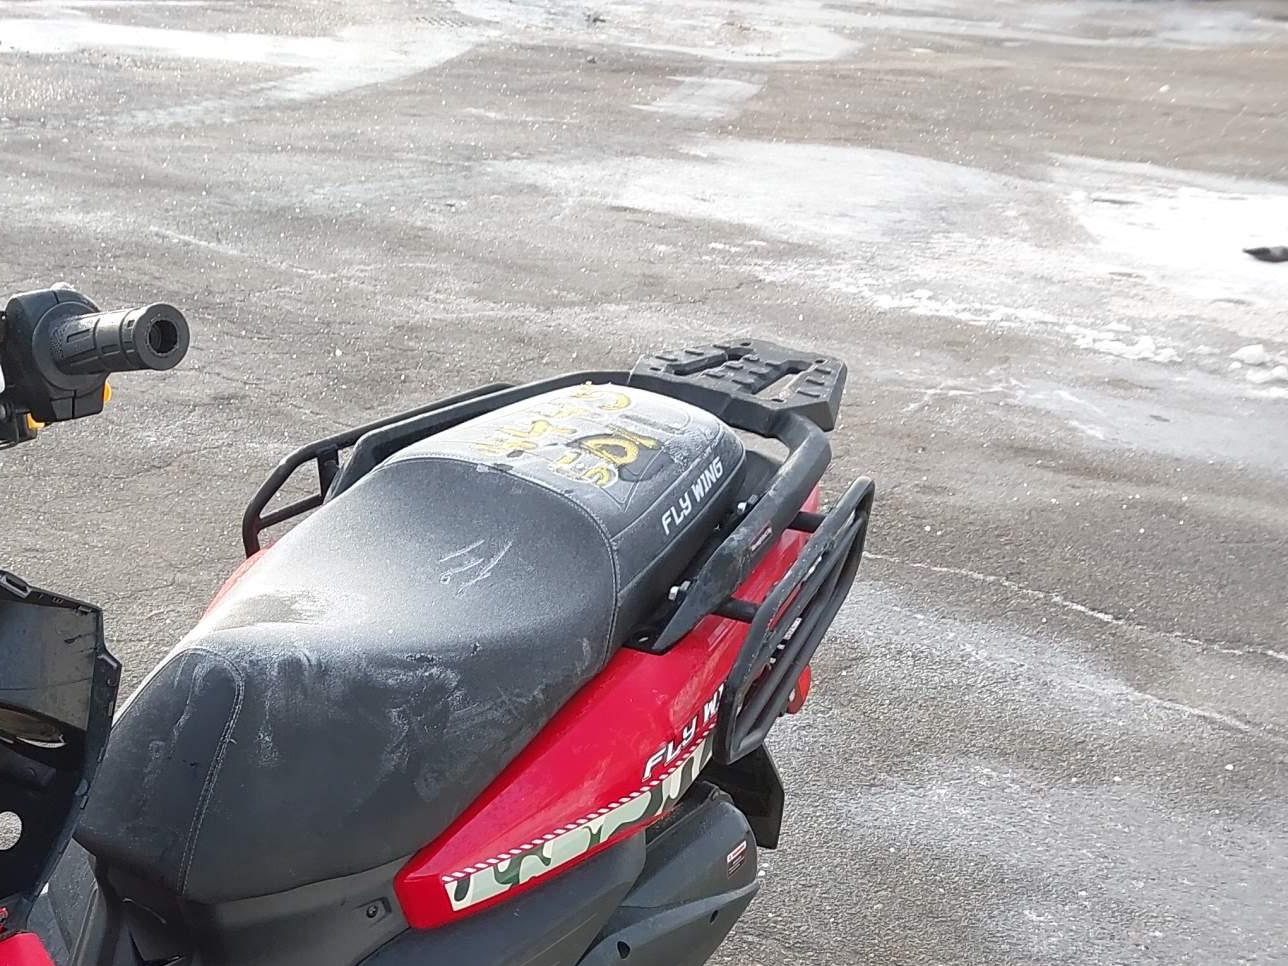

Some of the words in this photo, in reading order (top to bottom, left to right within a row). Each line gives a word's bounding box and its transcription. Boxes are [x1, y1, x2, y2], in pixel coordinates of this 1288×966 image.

[662, 491, 692, 536] FLY
[691, 455, 724, 503] WING
[641, 714, 698, 782] FLY
